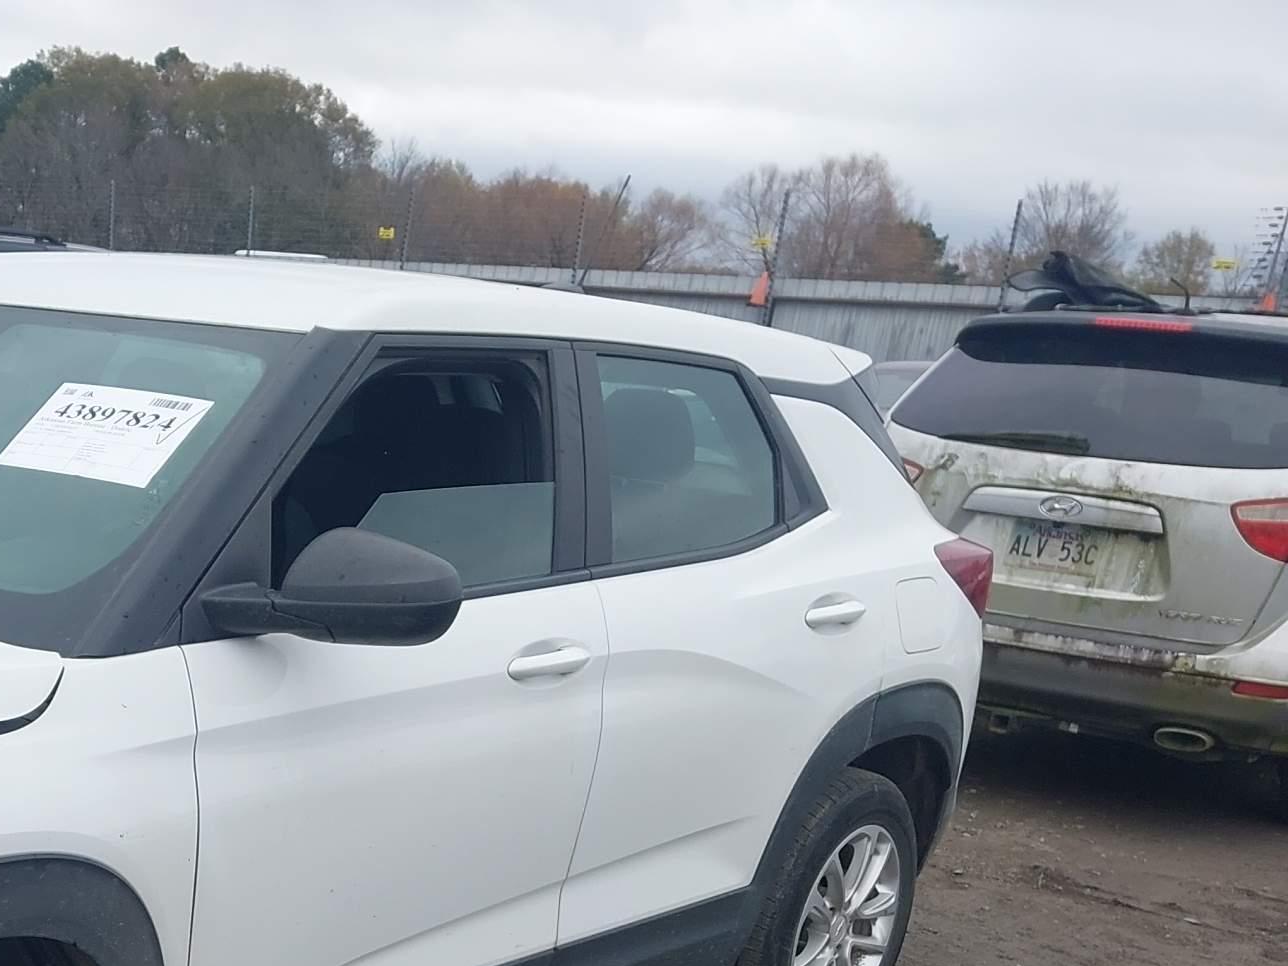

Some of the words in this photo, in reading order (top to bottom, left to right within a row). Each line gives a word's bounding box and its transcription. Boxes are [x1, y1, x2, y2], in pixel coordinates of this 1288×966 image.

[55, 402, 177, 432] 43897824
[1009, 534, 1049, 559] ALV
[1058, 540, 1098, 565] 53C
